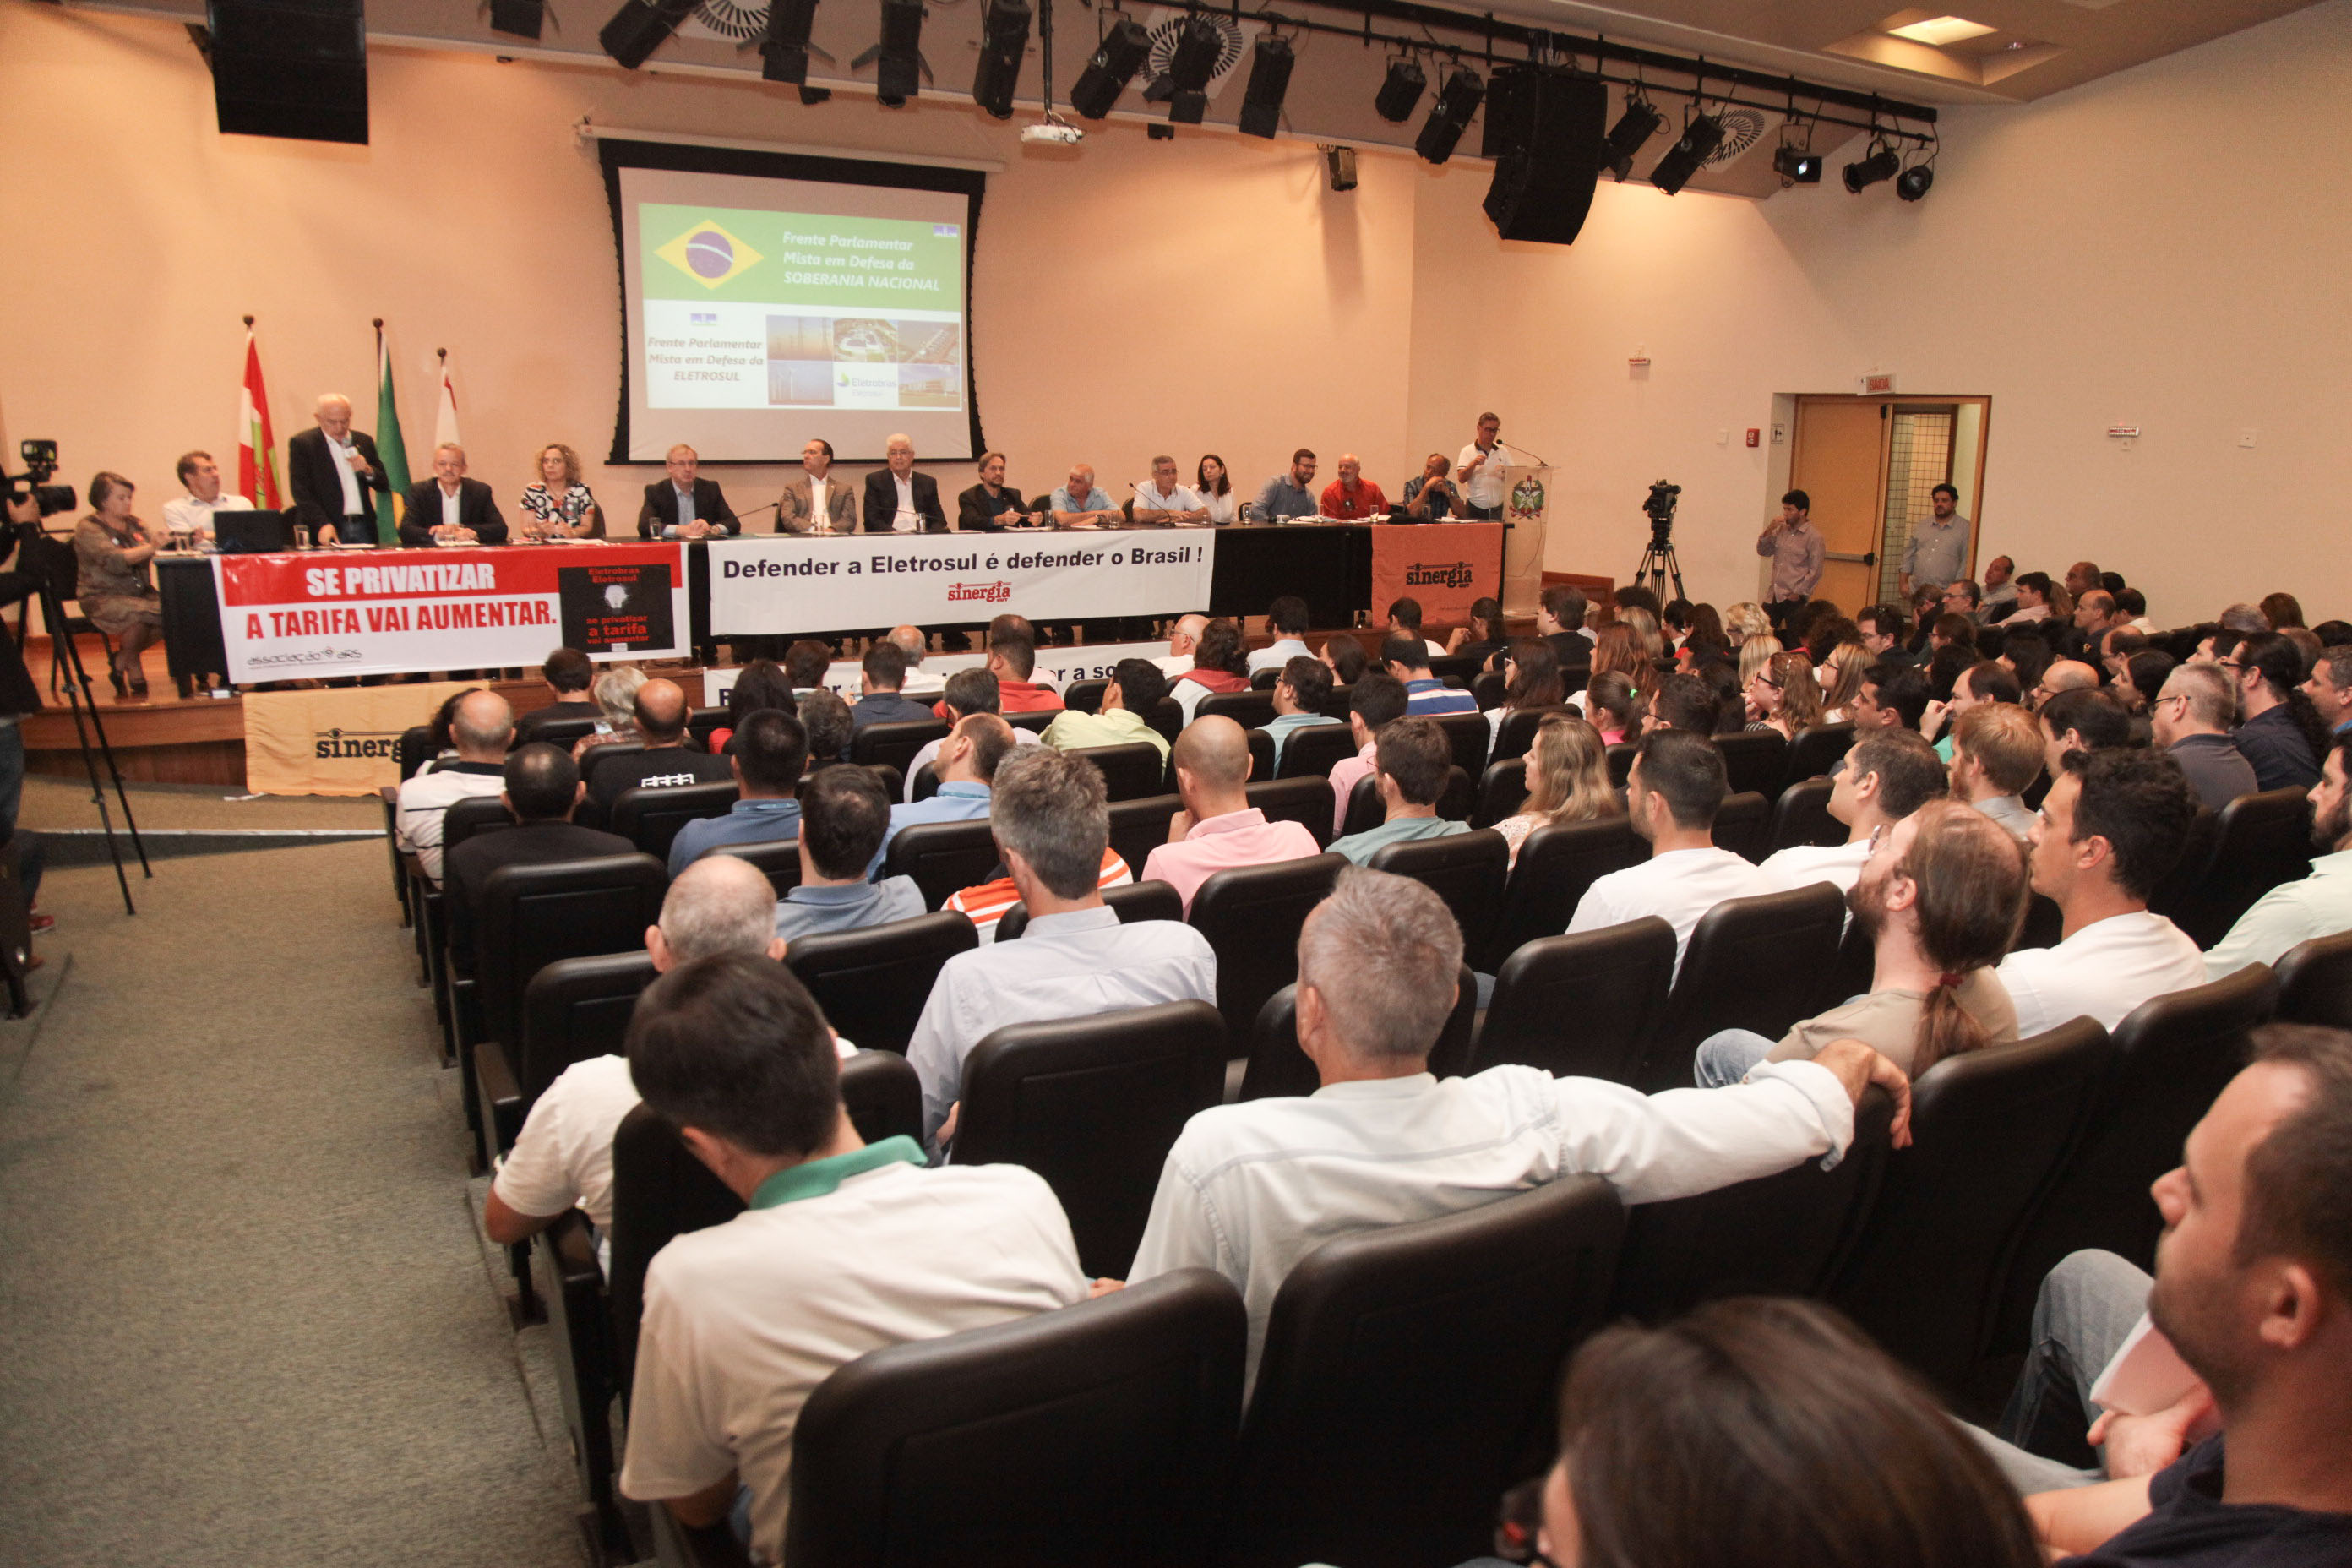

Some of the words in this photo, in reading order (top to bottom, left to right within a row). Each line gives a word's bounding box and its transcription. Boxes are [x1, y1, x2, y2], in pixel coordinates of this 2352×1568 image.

[783, 231, 826, 246] Frente
[829, 235, 913, 251] Parlamentar
[783, 252, 821, 265] Mista
[825, 257, 845, 267] em
[849, 255, 894, 270] Defesa
[898, 259, 915, 270] da
[784, 271, 864, 286] SOBERANIA
[868, 276, 939, 291] NACIONAL
[648, 337, 685, 348] Frente
[689, 338, 762, 349] Parlamentar
[649, 354, 681, 364] Mista
[706, 355, 745, 366] Defesa
[749, 356, 764, 365] da
[674, 371, 740, 381] ELETROSUL
[588, 567, 640, 575] Eletrobras
[723, 558, 840, 578] Defender
[847, 560, 862, 574] a
[871, 553, 977, 574] Eletrosul
[985, 553, 999, 569] é
[1006, 551, 1104, 569] defender
[1111, 553, 1124, 565] o
[1131, 547, 1190, 564] Brasil
[305, 568, 341, 596] SE
[345, 564, 496, 595] PRIVATIZAR
[592, 574, 637, 583] Eletrosul
[1406, 564, 1473, 588] sinergia
[948, 583, 1011, 602] sinergia
[247, 613, 264, 640] A
[270, 608, 361, 638] TARIFA
[365, 607, 409, 632] VAI
[417, 600, 557, 630] AUMENTAR.
[601, 615, 648, 624] privatizar
[589, 627, 598, 636] a
[603, 623, 647, 636] tarifa
[316, 734, 403, 764] sinerg
